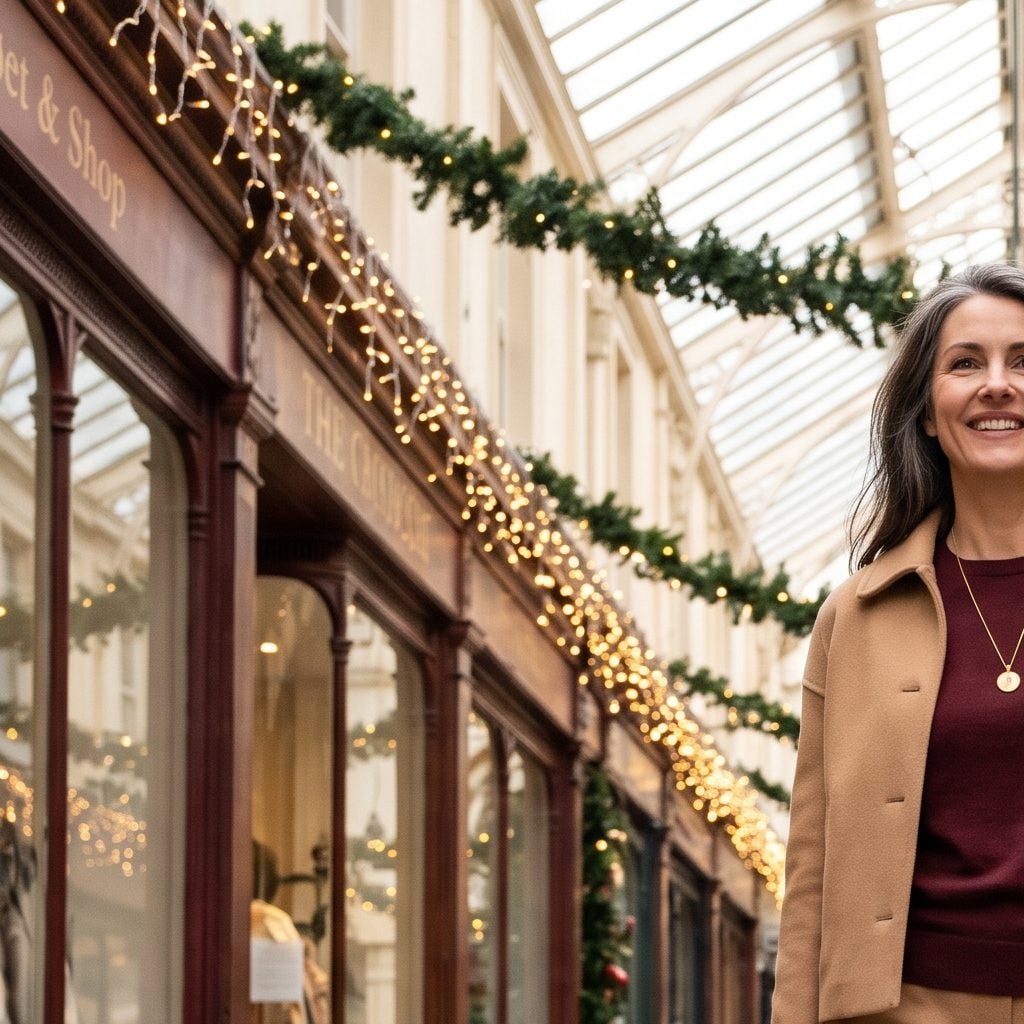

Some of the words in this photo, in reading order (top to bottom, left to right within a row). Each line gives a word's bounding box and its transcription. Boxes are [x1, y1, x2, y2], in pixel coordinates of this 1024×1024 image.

[0, 32, 29, 111] et
[37, 74, 60, 144] &
[68, 105, 126, 231] Shop
[302, 369, 345, 472] THE
